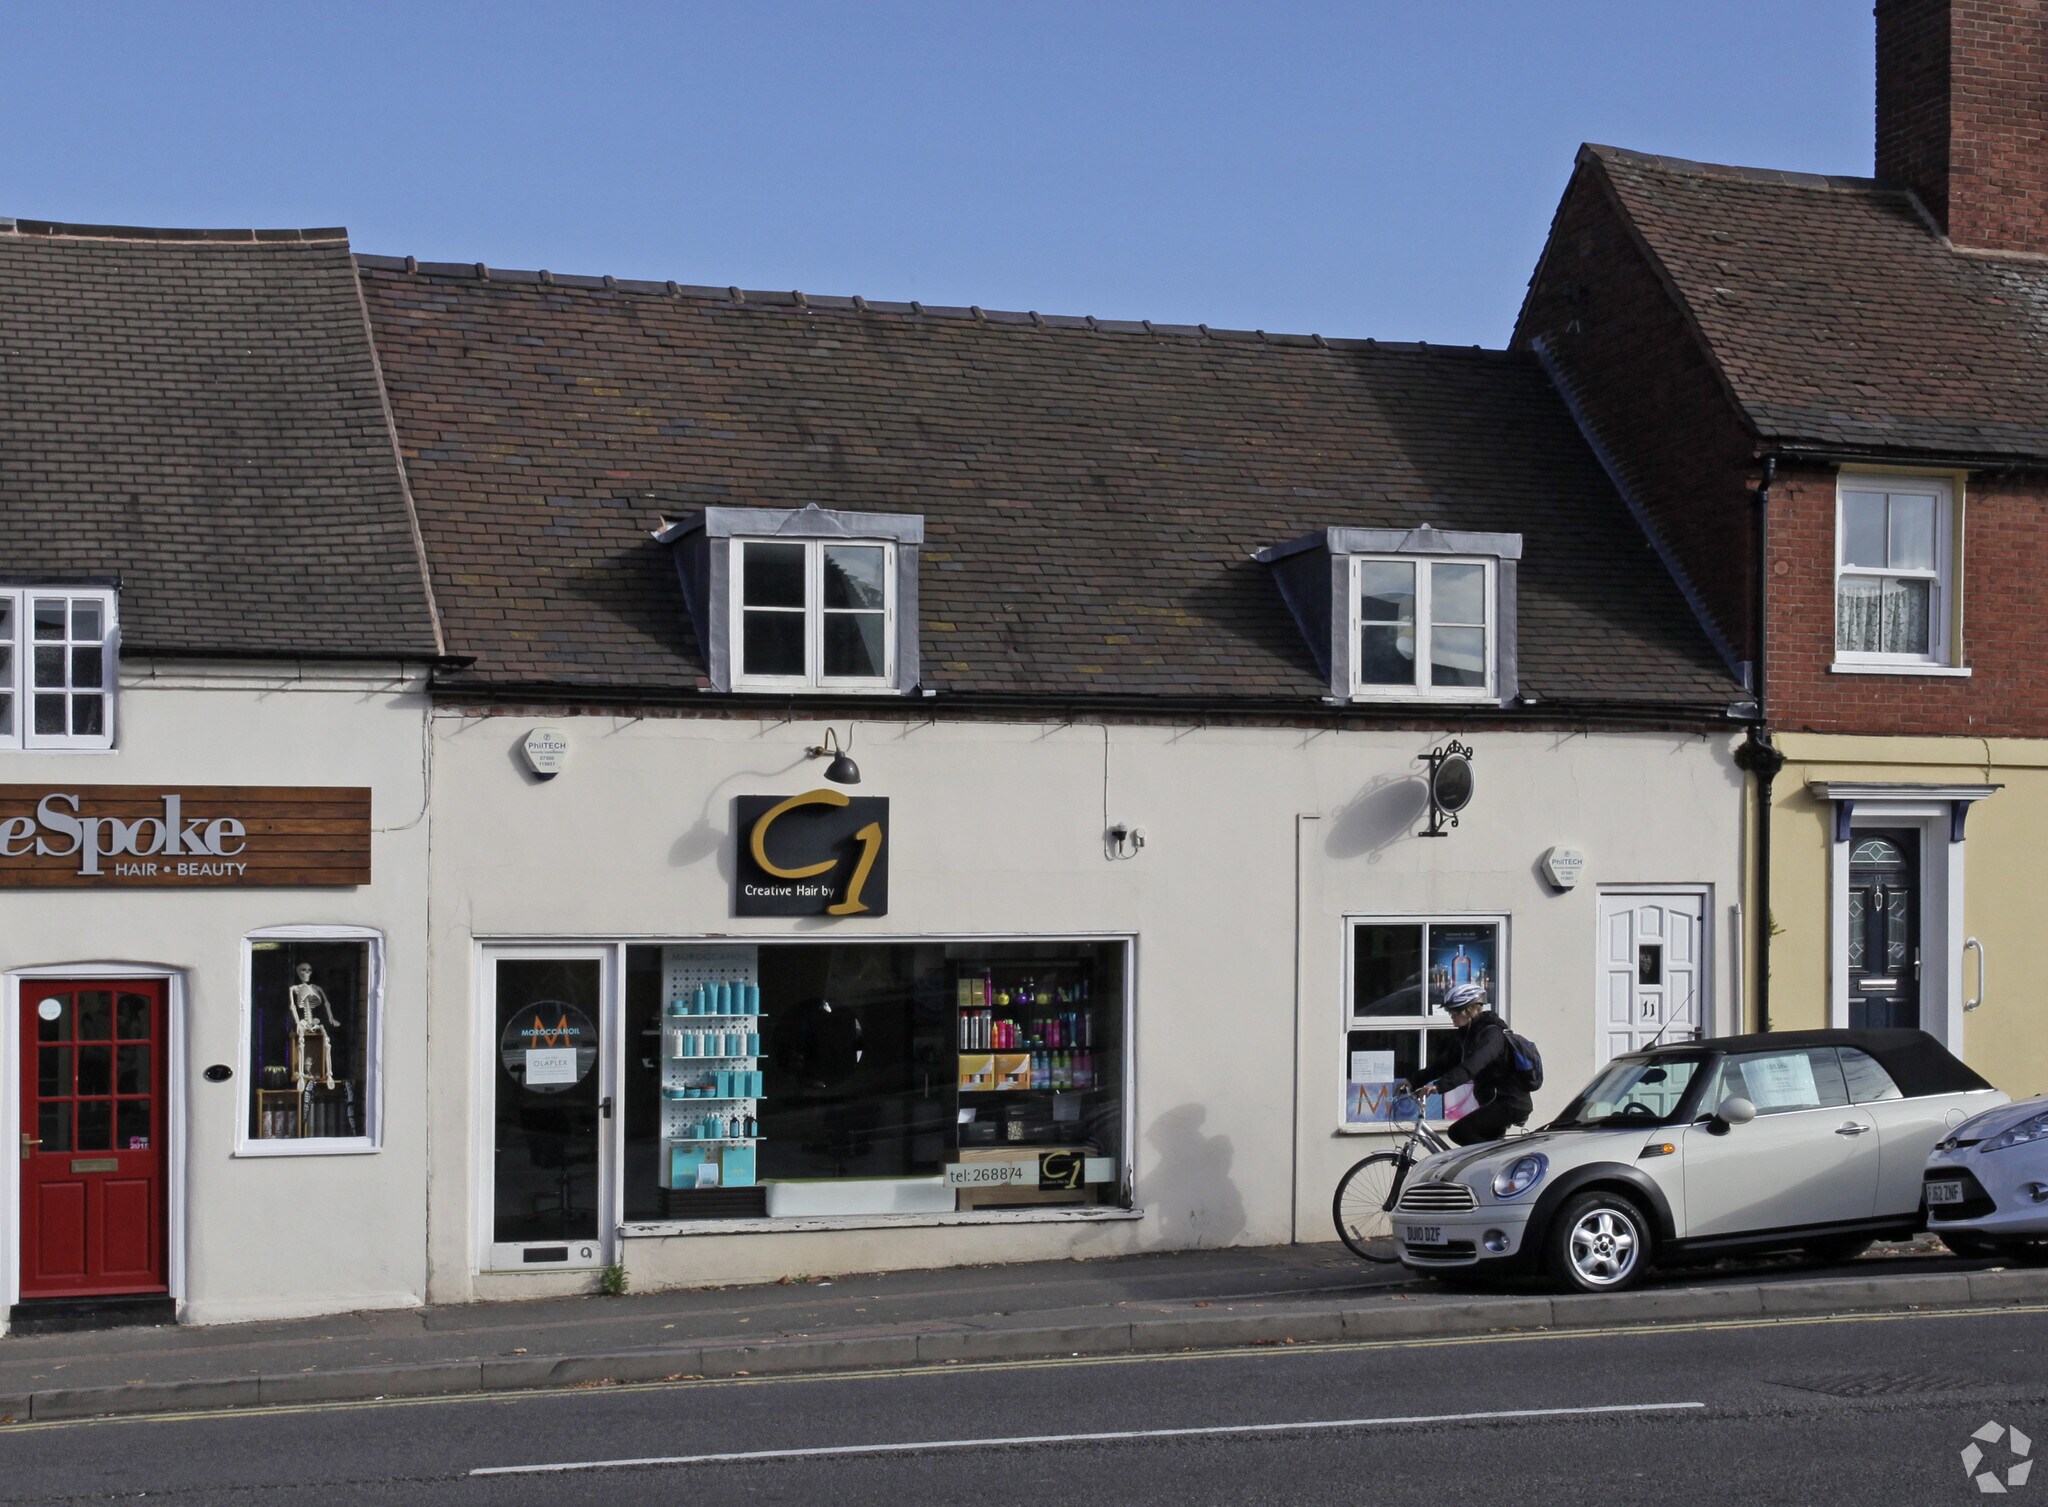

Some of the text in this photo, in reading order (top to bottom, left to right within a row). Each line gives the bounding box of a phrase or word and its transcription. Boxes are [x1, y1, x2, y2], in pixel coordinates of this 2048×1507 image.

[528, 742, 567, 750] PhilTECH
[0, 793, 247, 876] eSpoke
[115, 862, 248, 876] HAIR BEAUTY
[1551, 858, 1583, 866] PhilTECH
[744, 884, 836, 899] Creative Hair by
[521, 1027, 581, 1037] MOROCCANOIL
[533, 1059, 568, 1067] OLAPLEX
[950, 1167, 1023, 1183] tel: 268874
[1943, 1184, 1959, 1201] ZNF
[1424, 1226, 1441, 1242] DZF
